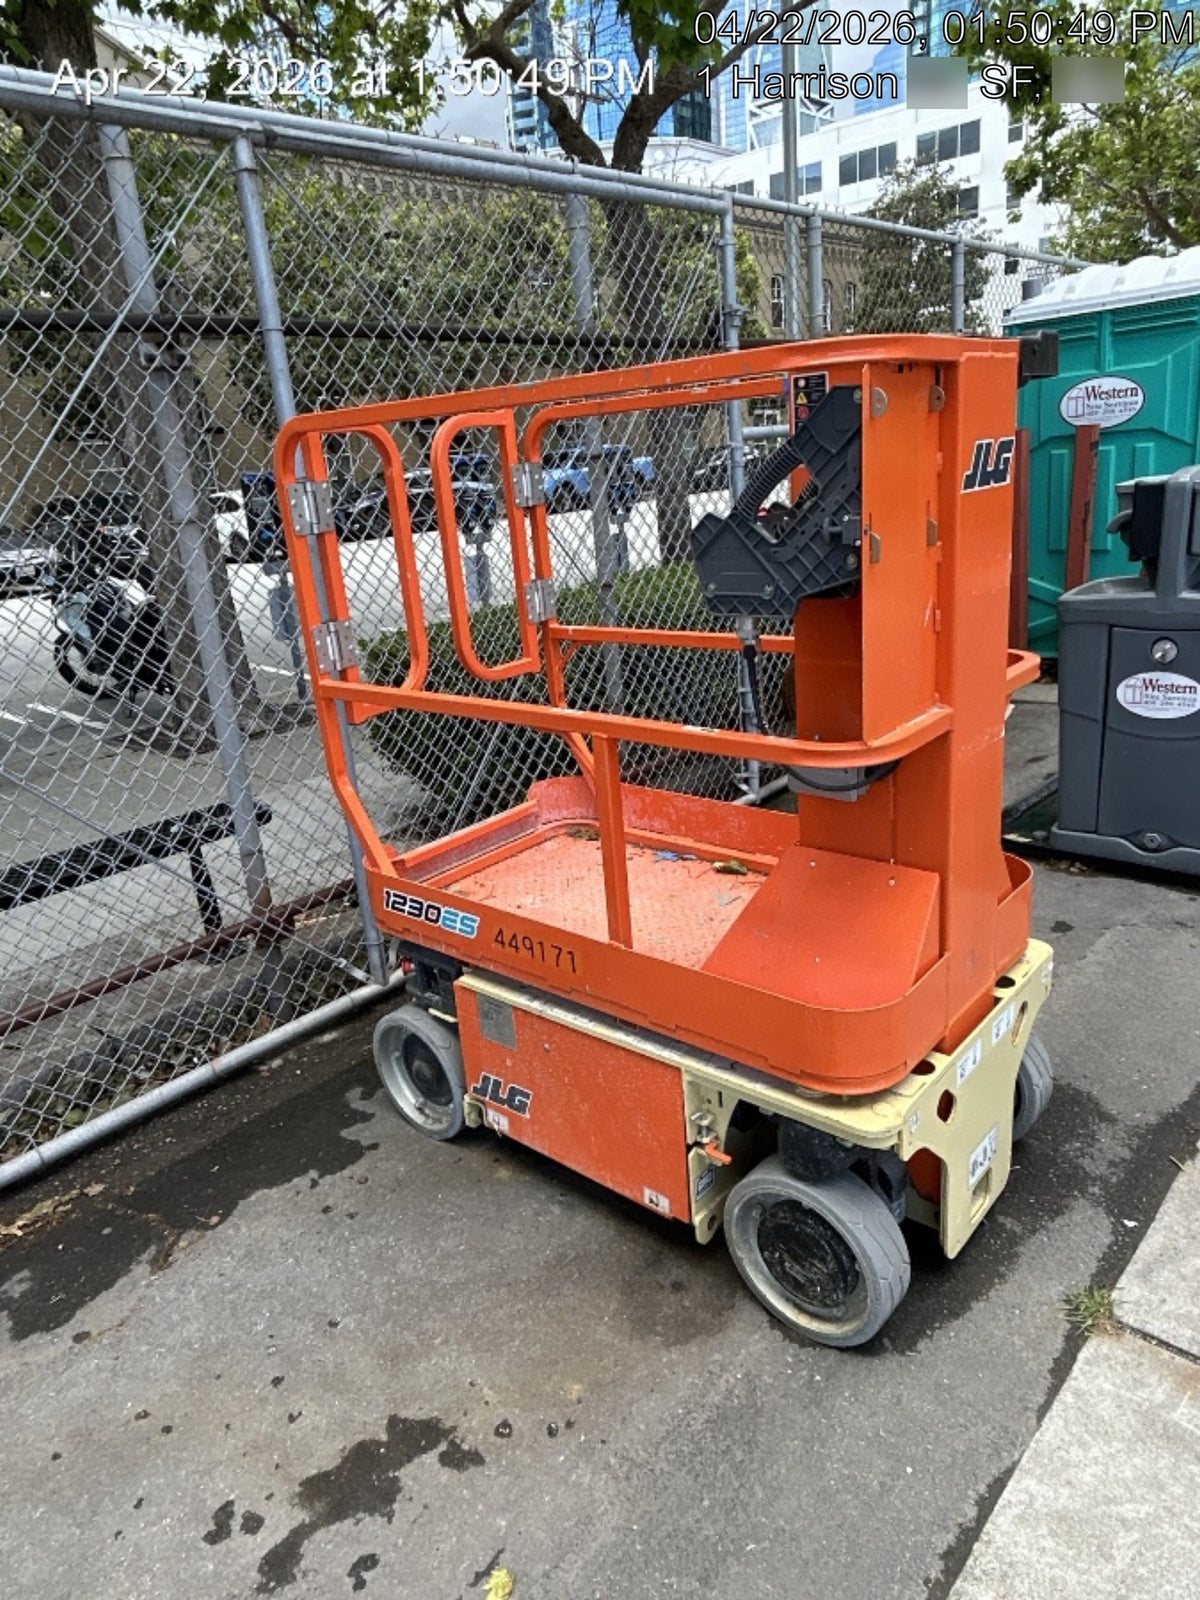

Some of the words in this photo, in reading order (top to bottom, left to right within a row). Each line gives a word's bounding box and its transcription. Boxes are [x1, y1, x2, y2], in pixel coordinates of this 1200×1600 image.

[1085, 385, 1139, 400] Western
[961, 436, 1016, 494] JLG
[1142, 678, 1198, 694] Western
[384, 889, 479, 938] 1230ES
[494, 928, 577, 974] 449171
[471, 1073, 532, 1117] JLG
